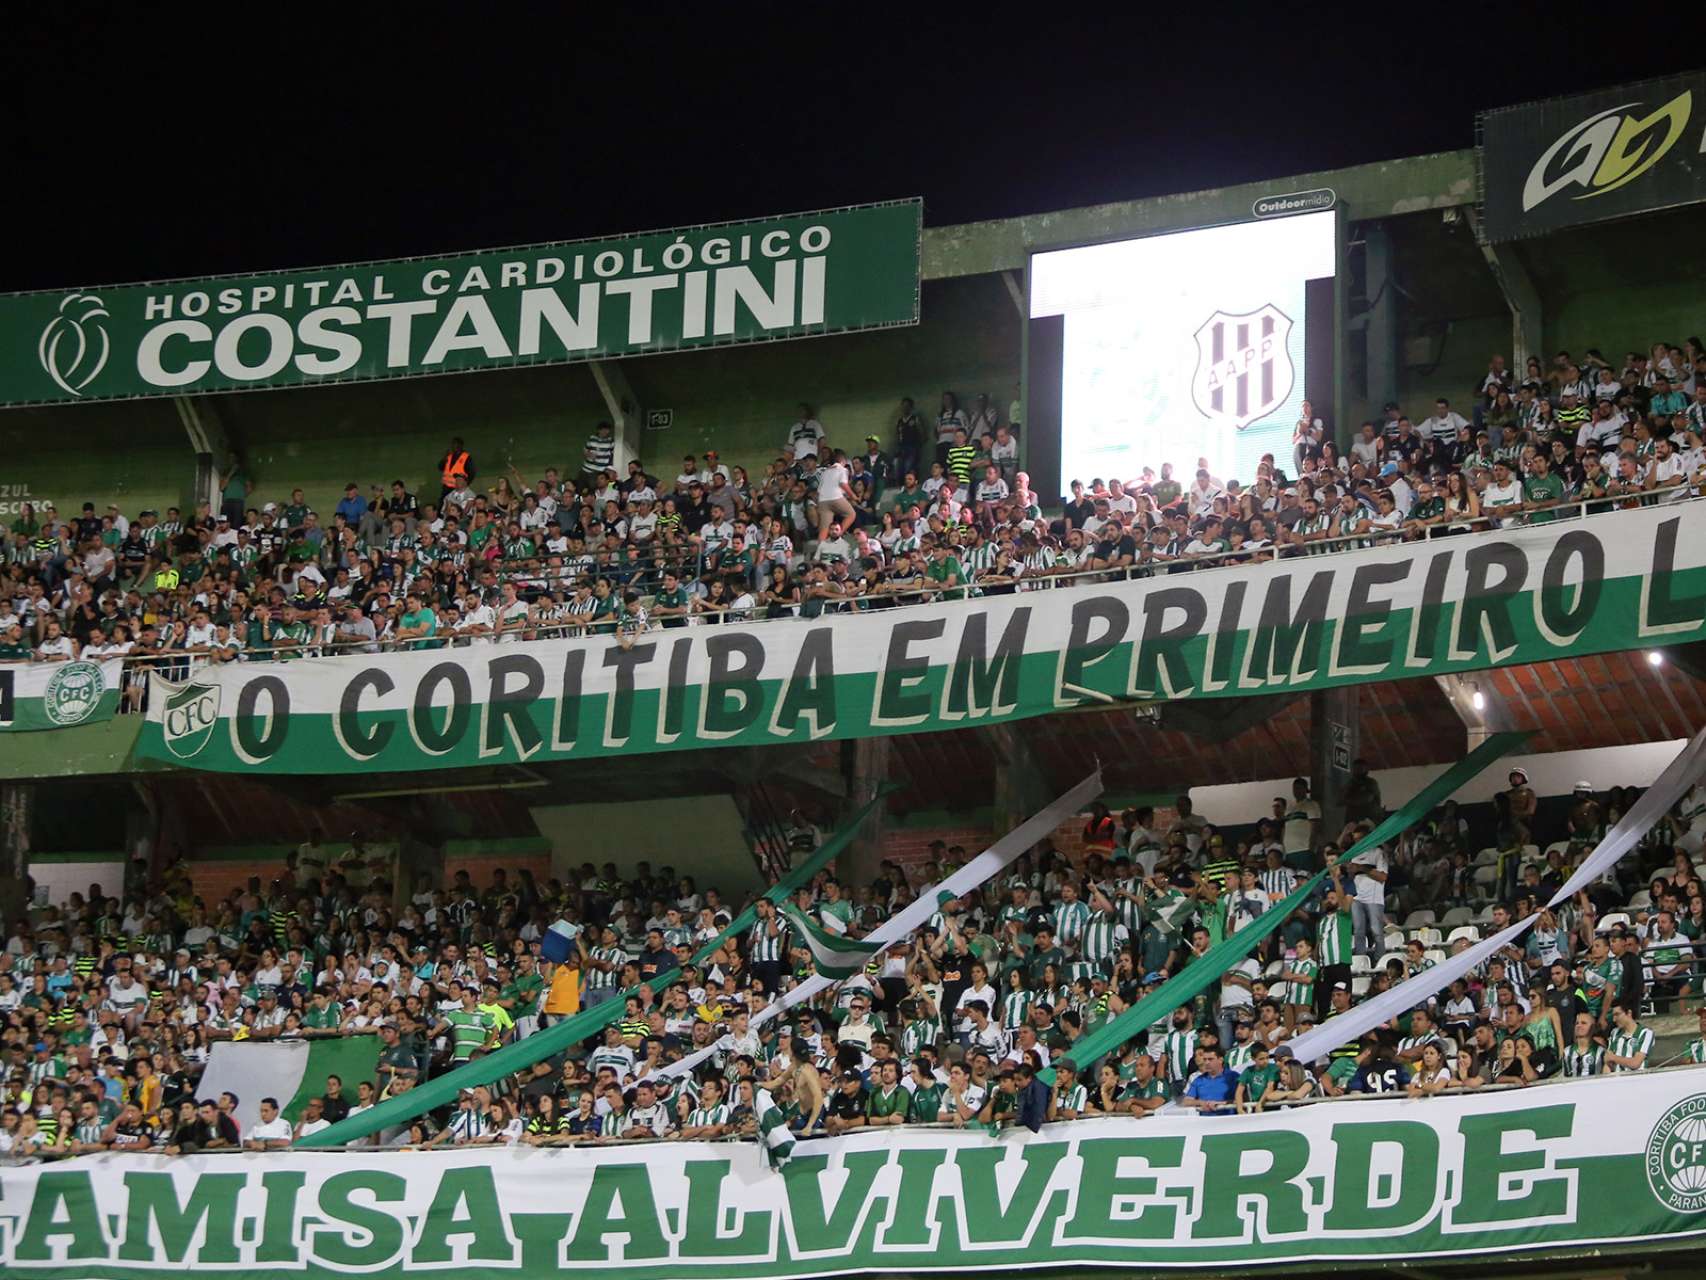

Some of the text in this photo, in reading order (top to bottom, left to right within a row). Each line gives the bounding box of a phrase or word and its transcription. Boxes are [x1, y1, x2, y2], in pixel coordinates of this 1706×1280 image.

[145, 225, 832, 321] HOSPITAL CARDIOLÓGICO
[136, 255, 827, 387] COSTANTINI
[1207, 339, 1273, 389] AAPP
[228, 674, 291, 765] O
[332, 626, 838, 762] CORITIBA
[870, 606, 1032, 727] EM
[1053, 529, 1606, 708] PRIMEIRO
[61, 685, 90, 702] CFC
[168, 696, 216, 738] CFC
[1649, 1114, 1680, 1175] CORITIBA
[0, 1103, 1578, 1270] AMISA ALVIVERDE
